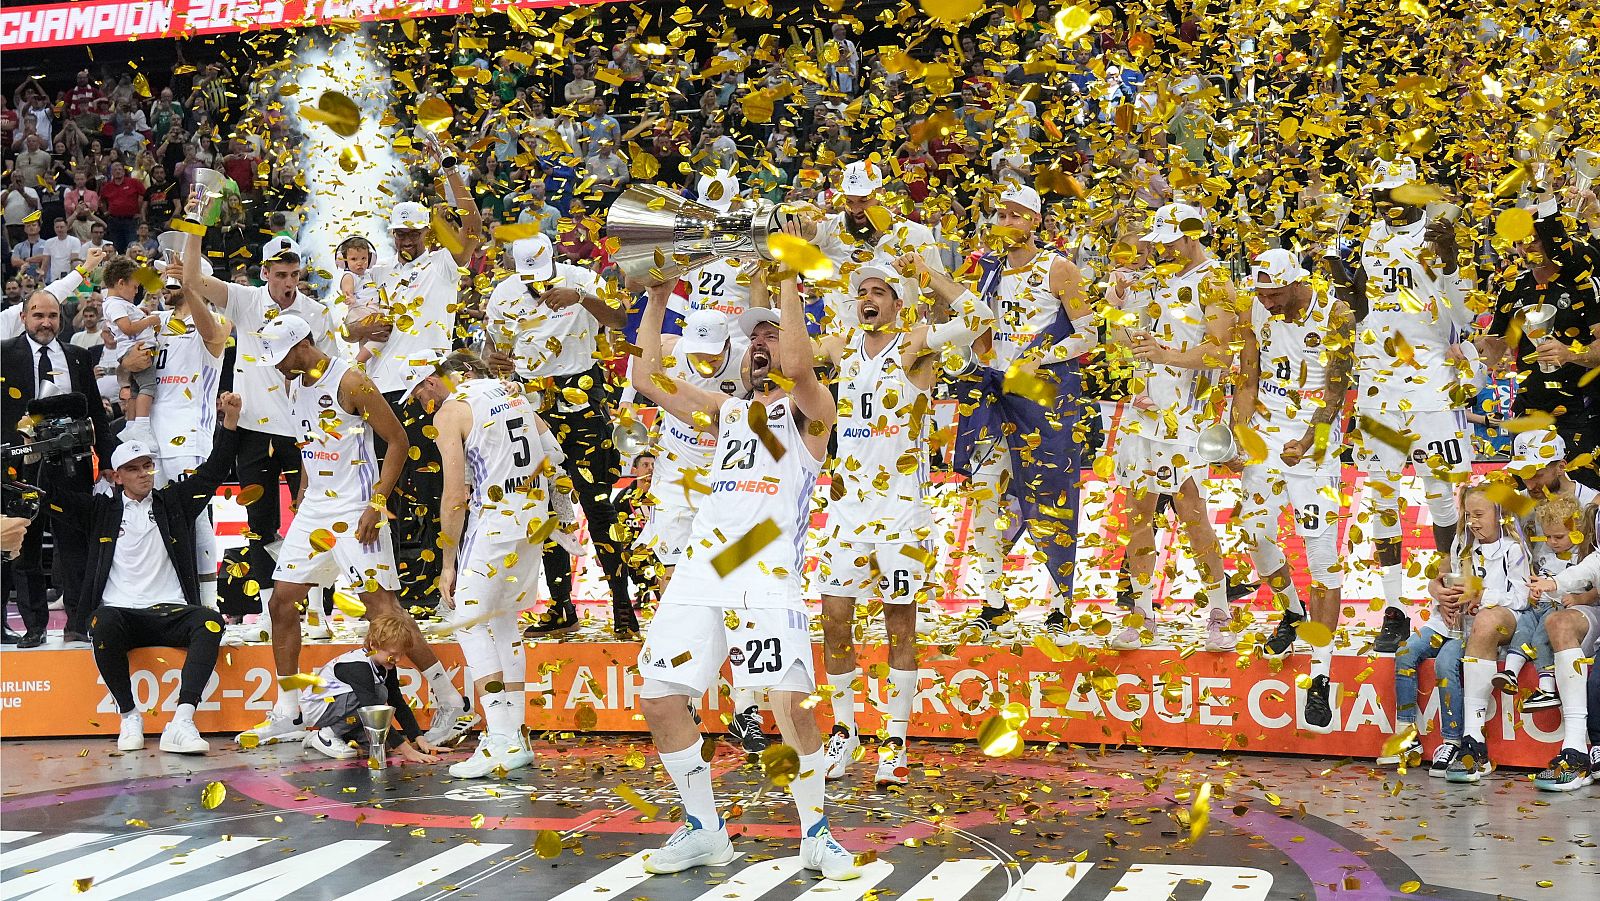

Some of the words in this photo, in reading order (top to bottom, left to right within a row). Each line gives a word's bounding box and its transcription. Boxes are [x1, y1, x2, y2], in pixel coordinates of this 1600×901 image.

[0, 0, 174, 45] CHAMPION
[699, 271, 725, 296] 22
[1384, 267, 1413, 293] 30
[156, 375, 189, 385] OHERO
[1263, 381, 1324, 399] AUTOERO
[861, 393, 873, 419] 6
[506, 417, 531, 467] 5
[670, 427, 717, 447] AUTOHE
[843, 425, 900, 438] AUTOHRO
[11, 446, 33, 456] RONIN
[302, 451, 340, 461] TOHERO
[721, 439, 757, 470] 23
[1428, 439, 1463, 465] 30
[894, 570, 909, 596] 6
[746, 638, 782, 674] 23
[96, 668, 274, 713] 2022-2
